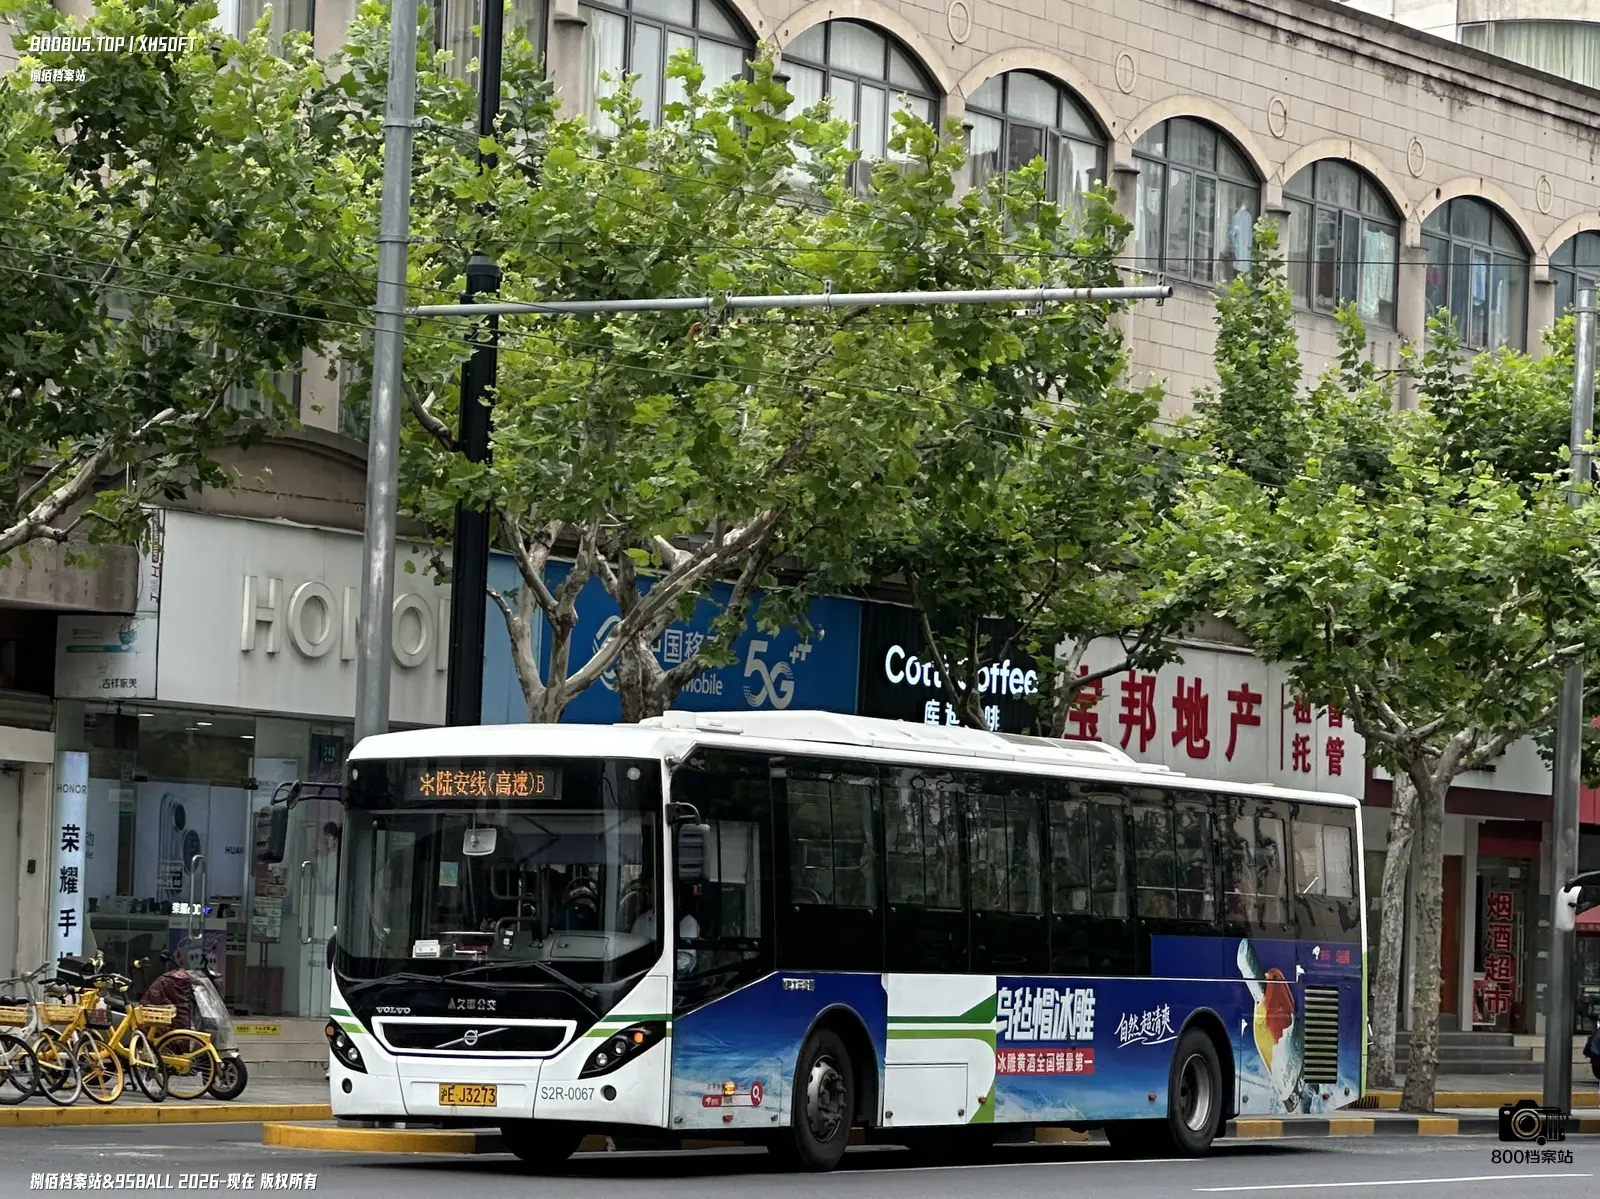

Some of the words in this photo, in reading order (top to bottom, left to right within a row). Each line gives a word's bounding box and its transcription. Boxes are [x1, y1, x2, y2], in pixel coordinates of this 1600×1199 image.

[1292, 733, 1345, 776] 托管
[57, 783, 87, 794] HONOR
[1484, 892, 1513, 1015] 烟酒超市
[376, 1006, 411, 1014] VOLVO
[996, 986, 1096, 1041] 乌毡帽冰雕
[997, 1052, 1094, 1073] 冰雕黄酒全国销量第一
[541, 1086, 595, 1100] S2R-0067
